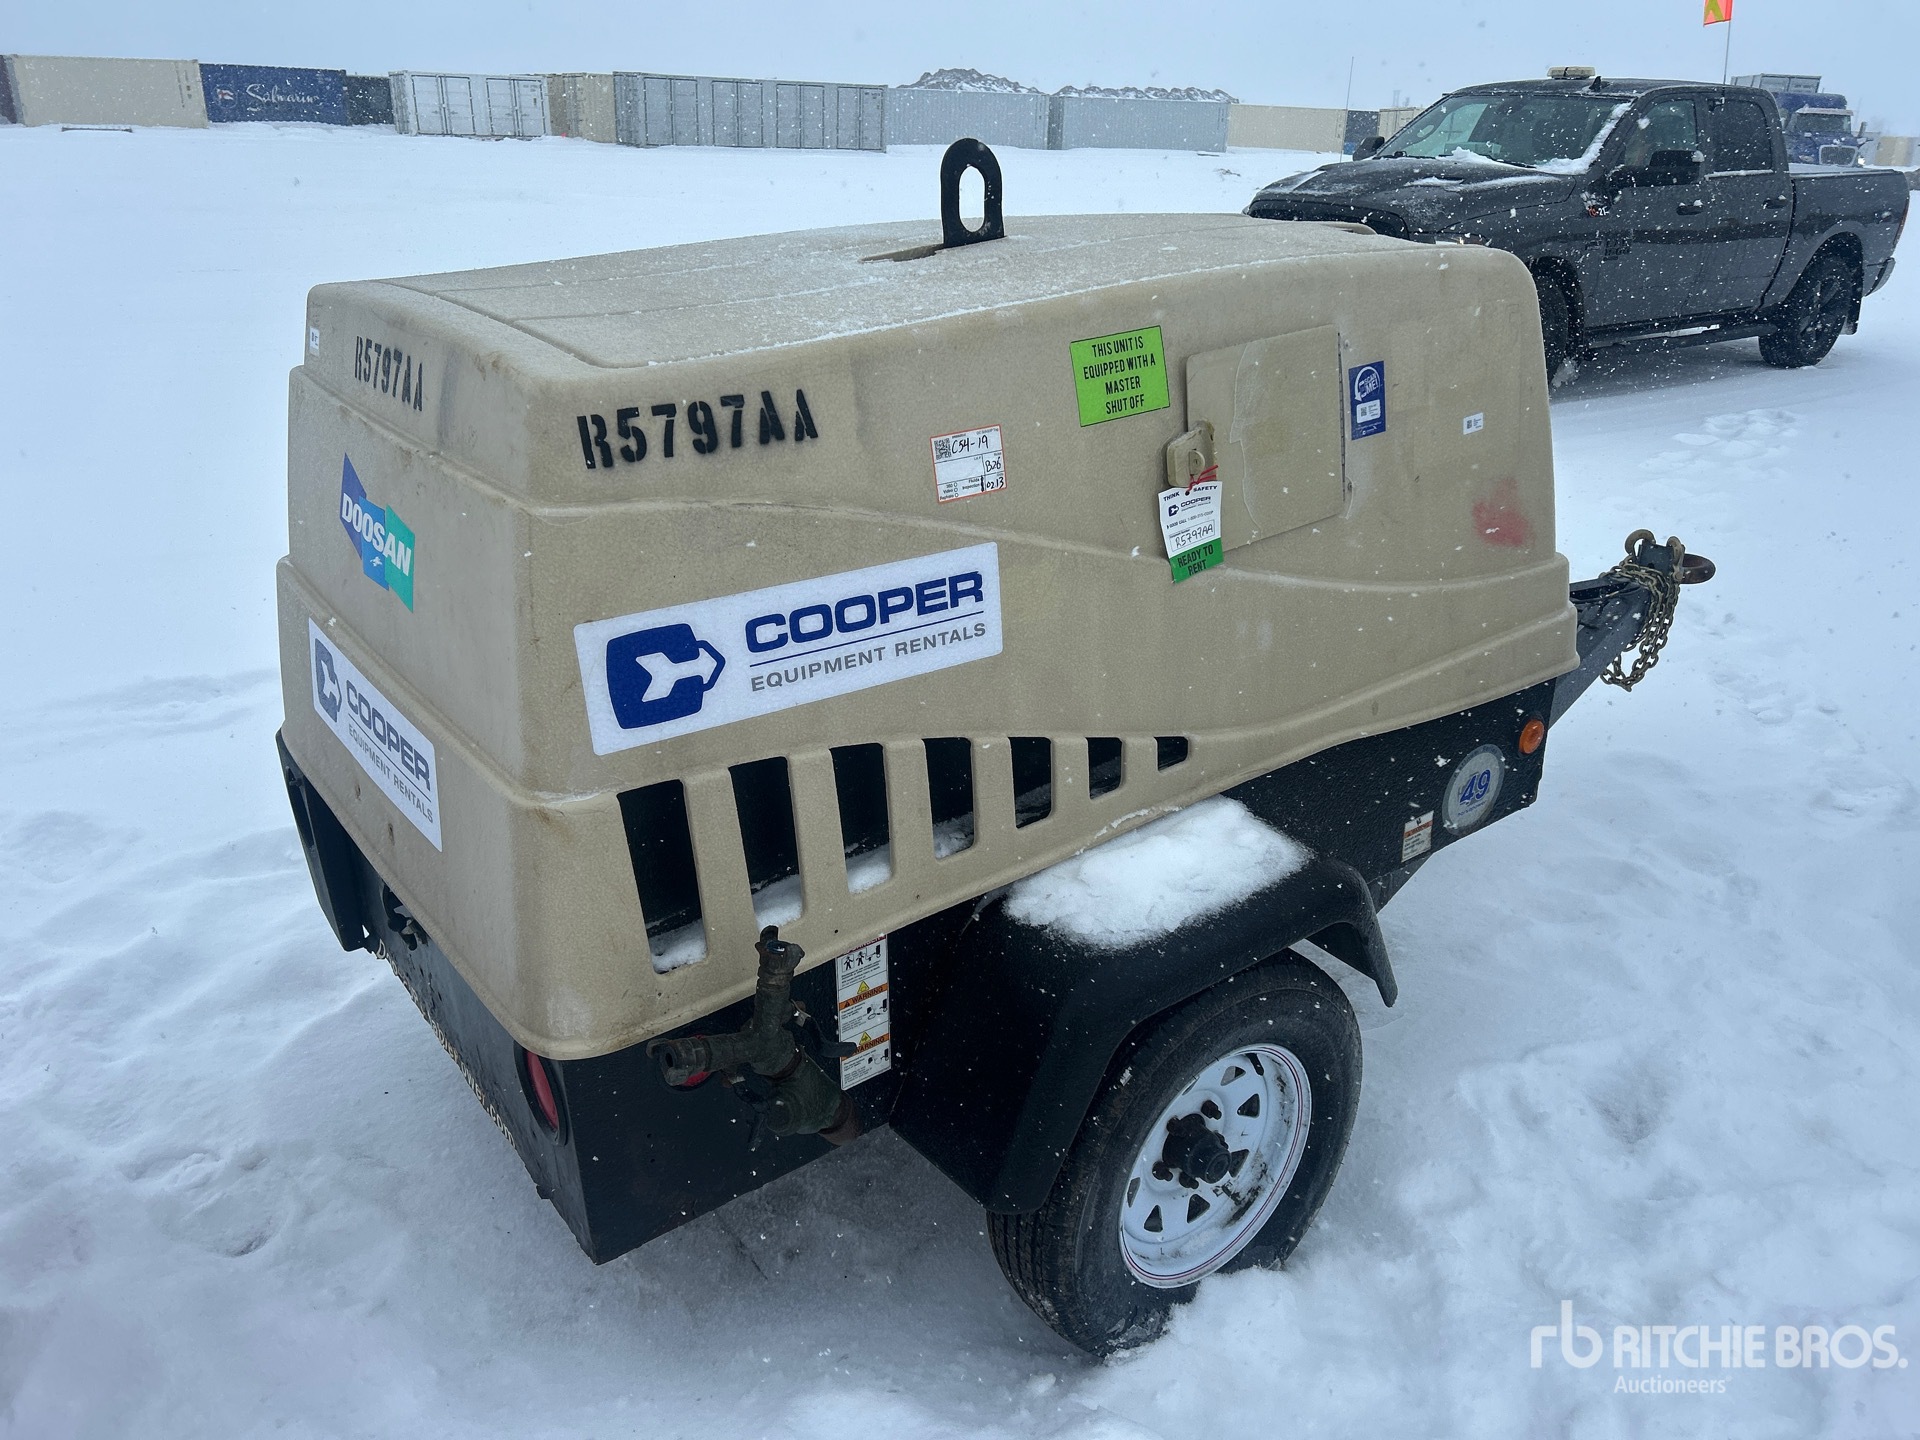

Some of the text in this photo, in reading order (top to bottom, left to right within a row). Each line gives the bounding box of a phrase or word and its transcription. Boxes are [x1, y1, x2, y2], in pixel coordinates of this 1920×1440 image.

[1091, 335, 1144, 358] THIS UNIT IS
[354, 335, 423, 412] R5797AA
[1083, 352, 1156, 380] EQUIPPED WITH A
[1363, 372, 1378, 384] SCAN
[1105, 375, 1141, 396] MASTER
[1366, 378, 1379, 395] ME!
[1105, 393, 1145, 415] SHUT OFF
[576, 388, 819, 470] R5797AA
[985, 456, 1002, 473] B26
[1163, 485, 1218, 502] THINK SAFETY
[1180, 496, 1211, 508] COOPER
[341, 492, 412, 577] DOOSAN
[1175, 523, 1214, 549] R5797AA
[1177, 543, 1214, 568] READY TO
[1187, 559, 1207, 576] RENT
[745, 570, 984, 654] COOPER
[750, 622, 987, 692] EQUIPMENT RENTALS
[346, 679, 431, 792] COOPER
[348, 724, 434, 824] EQUIPMENT RENTALS
[1459, 769, 1491, 803] 49
[852, 986, 883, 1004] WARNING
